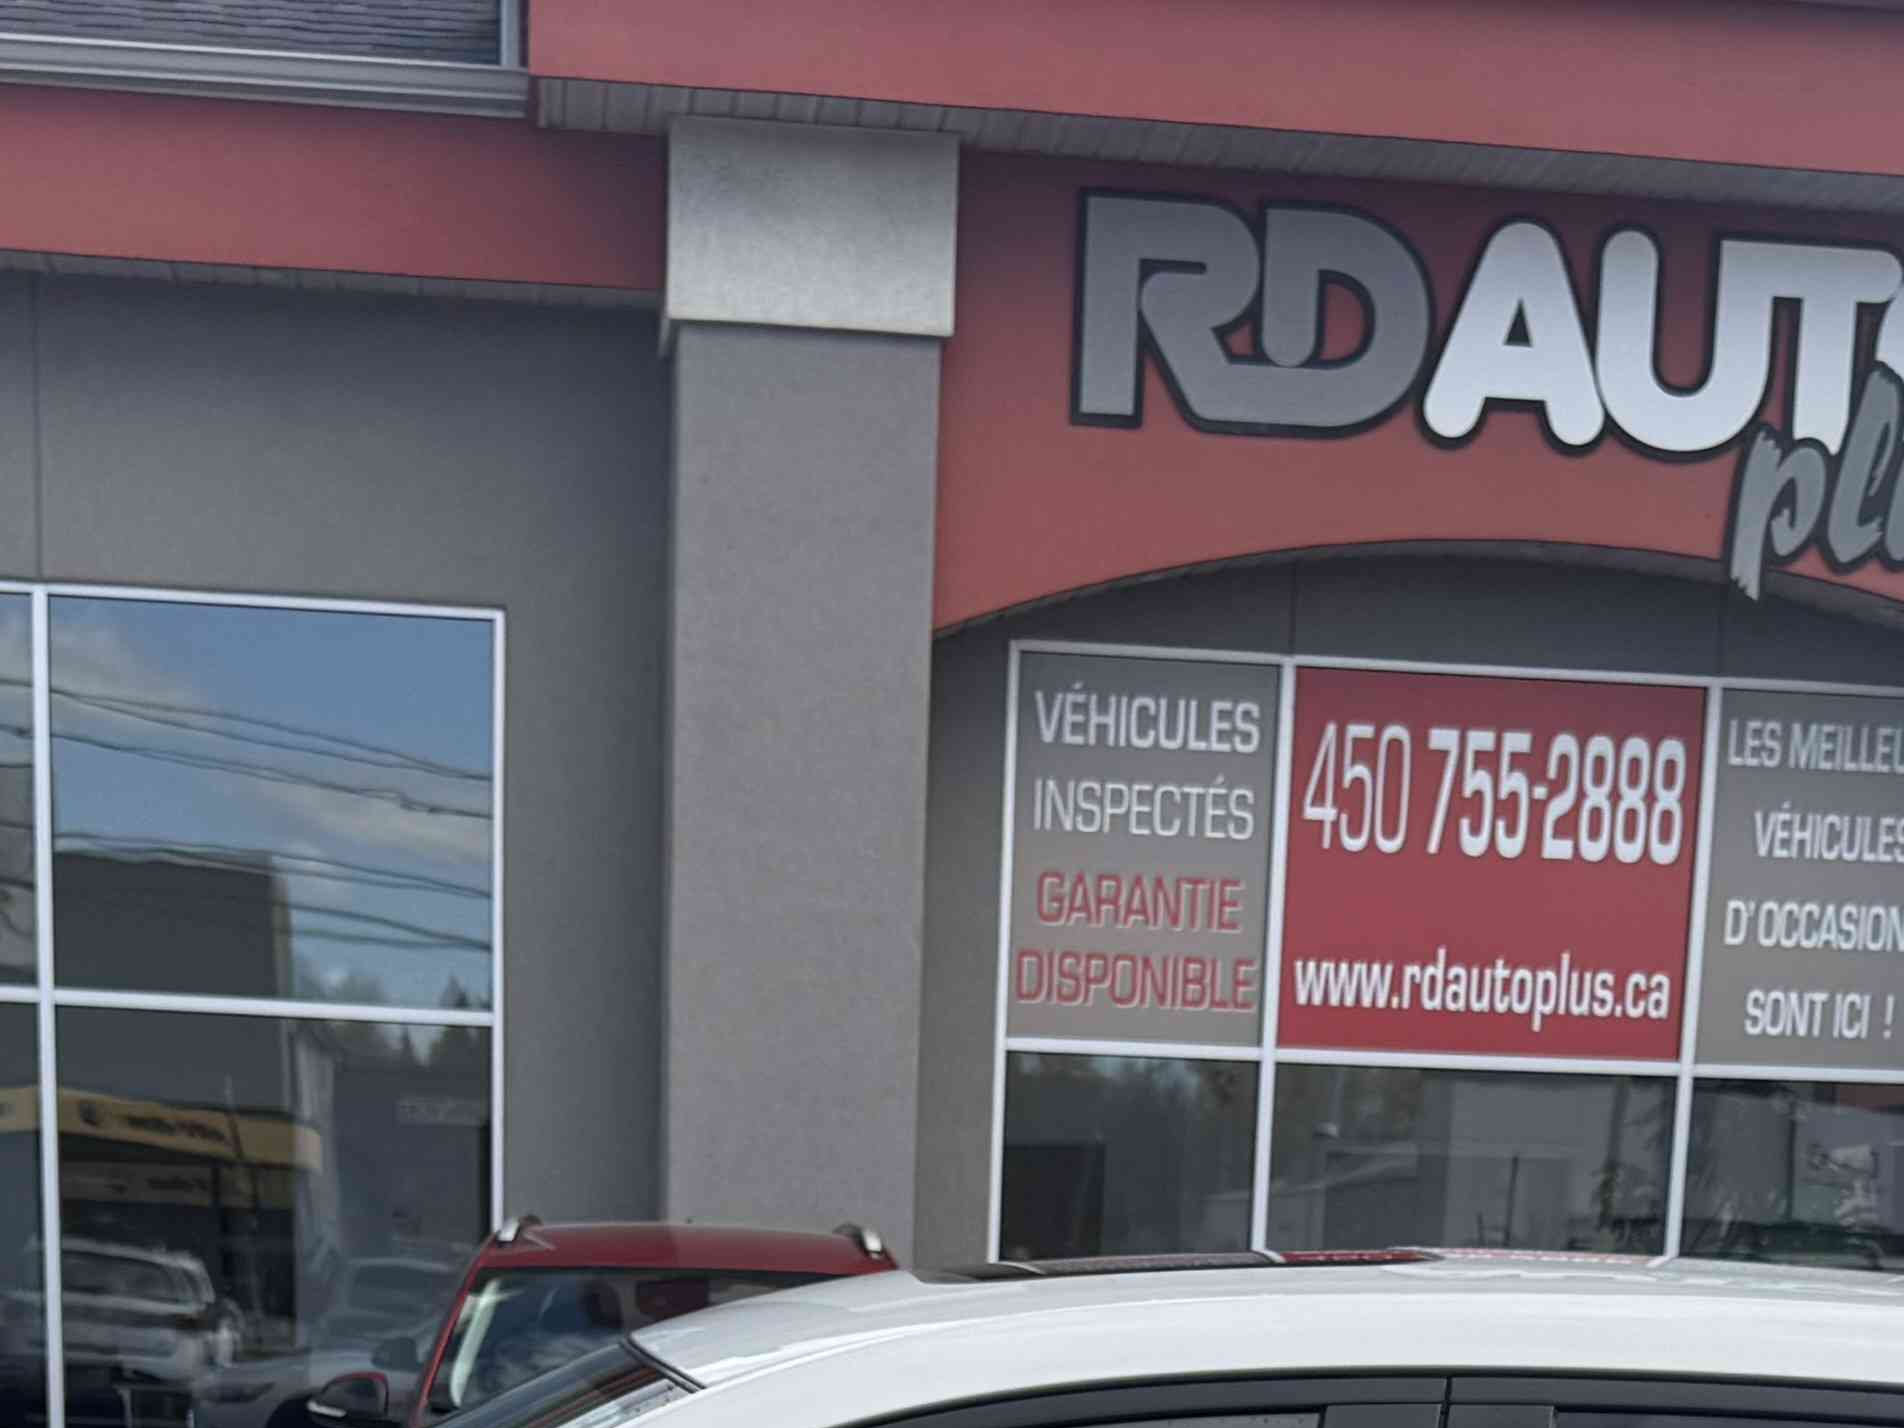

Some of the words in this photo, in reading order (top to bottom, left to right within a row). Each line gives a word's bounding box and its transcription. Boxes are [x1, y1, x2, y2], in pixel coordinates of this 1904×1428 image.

[1034, 681, 1261, 754] VÉHICULES
[1727, 719, 1783, 768] LES
[1033, 773, 1256, 840] INSPECTÉS
[1302, 722, 1412, 854] 450
[1425, 727, 1687, 866] 755-2888
[1036, 871, 1245, 934] GARANTIE
[1015, 948, 1258, 1013] DISPONIBLE
[1294, 946, 1671, 1033] www.rdautoplus.ca
[1743, 988, 1831, 1038] SONT
[1832, 993, 1872, 1040] ICI
